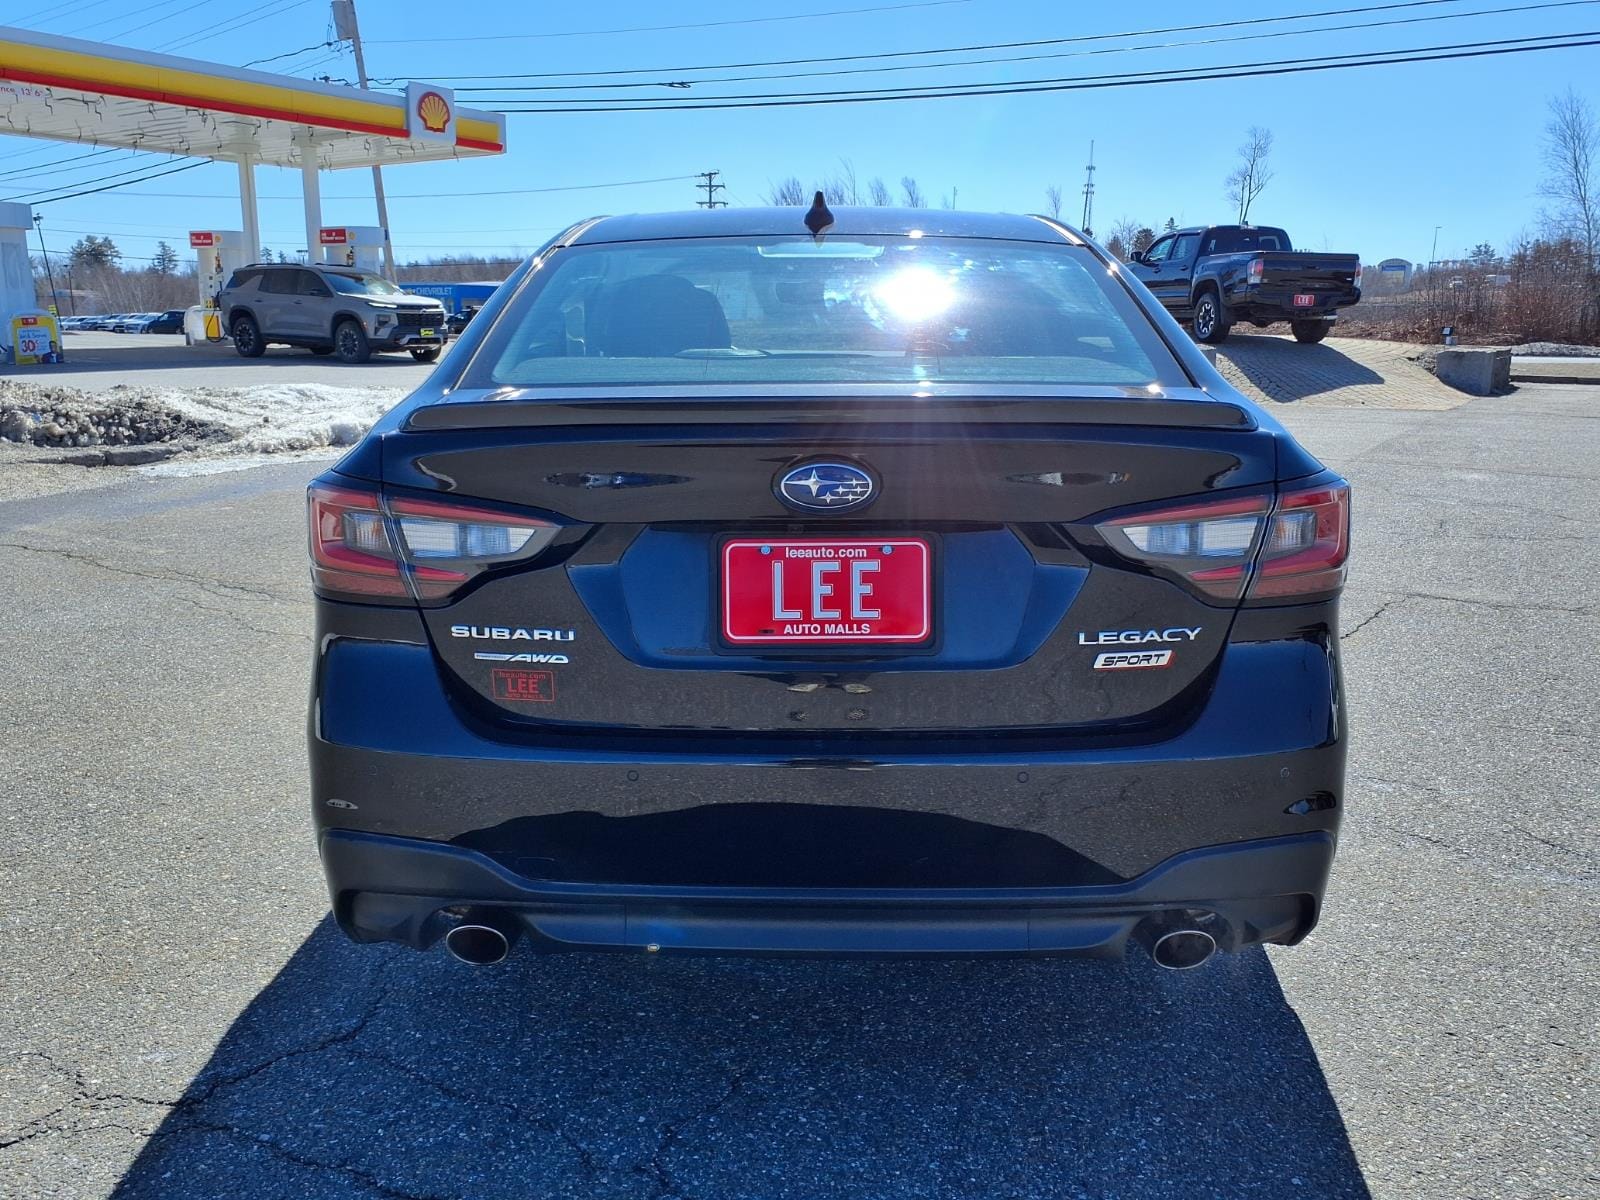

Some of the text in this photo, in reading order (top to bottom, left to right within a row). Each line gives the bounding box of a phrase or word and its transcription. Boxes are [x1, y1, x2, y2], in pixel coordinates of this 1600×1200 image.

[416, 287, 452, 295] CHEVROLET
[785, 547, 867, 558] leeauto.com
[772, 560, 880, 620] LEE
[451, 625, 575, 641] SUBARU
[783, 624, 871, 635] AUTO MALLS
[1079, 627, 1202, 645] LEGACY
[508, 652, 569, 663] AWD
[1101, 653, 1165, 667] SPORT
[499, 671, 546, 680] leeauto.com
[506, 678, 540, 694] LEE
